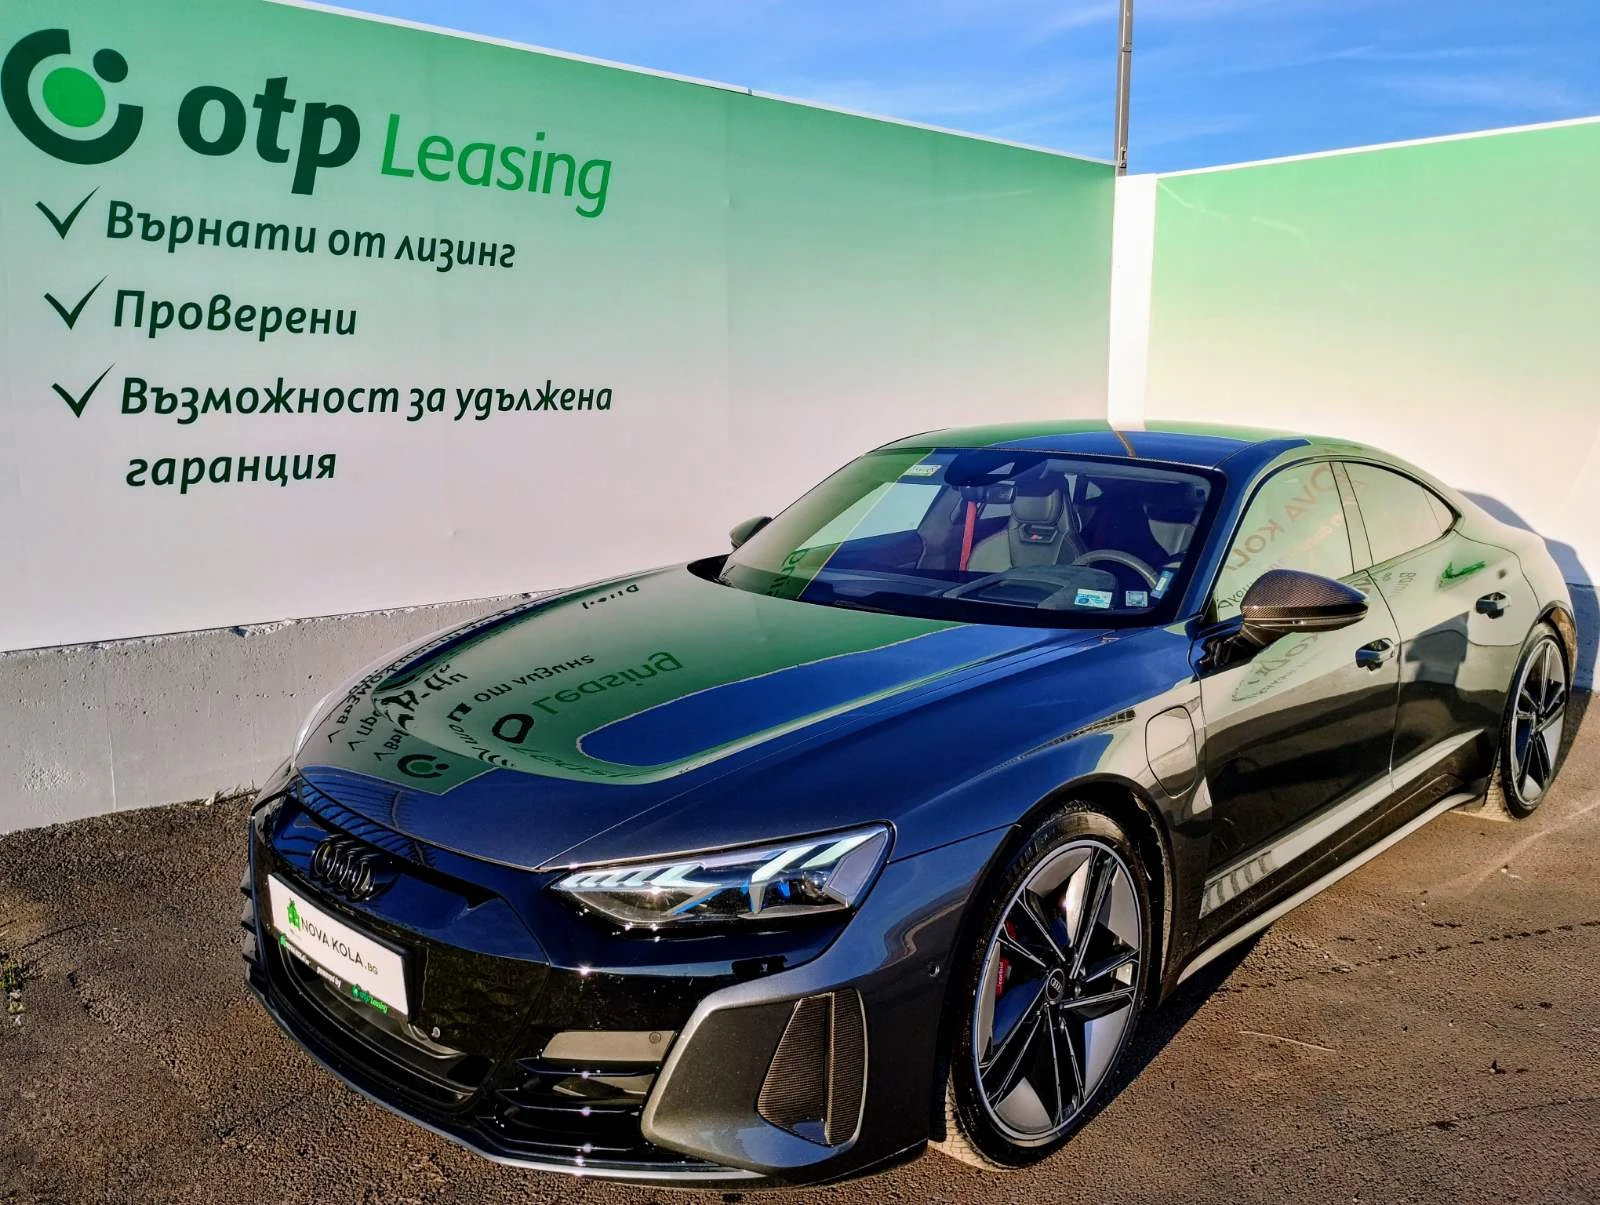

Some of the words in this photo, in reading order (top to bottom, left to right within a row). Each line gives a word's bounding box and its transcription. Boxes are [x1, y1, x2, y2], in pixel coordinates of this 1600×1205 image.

[177, 76, 361, 196] otp
[381, 113, 613, 218] Leasing
[106, 200, 317, 254] Върнати
[327, 229, 387, 259] от
[395, 235, 517, 273] лизинг
[113, 289, 357, 342] Проверени
[120, 376, 400, 425] Възможност
[406, 387, 446, 421] за
[454, 379, 614, 421] удължена
[125, 452, 338, 495] гаранция
